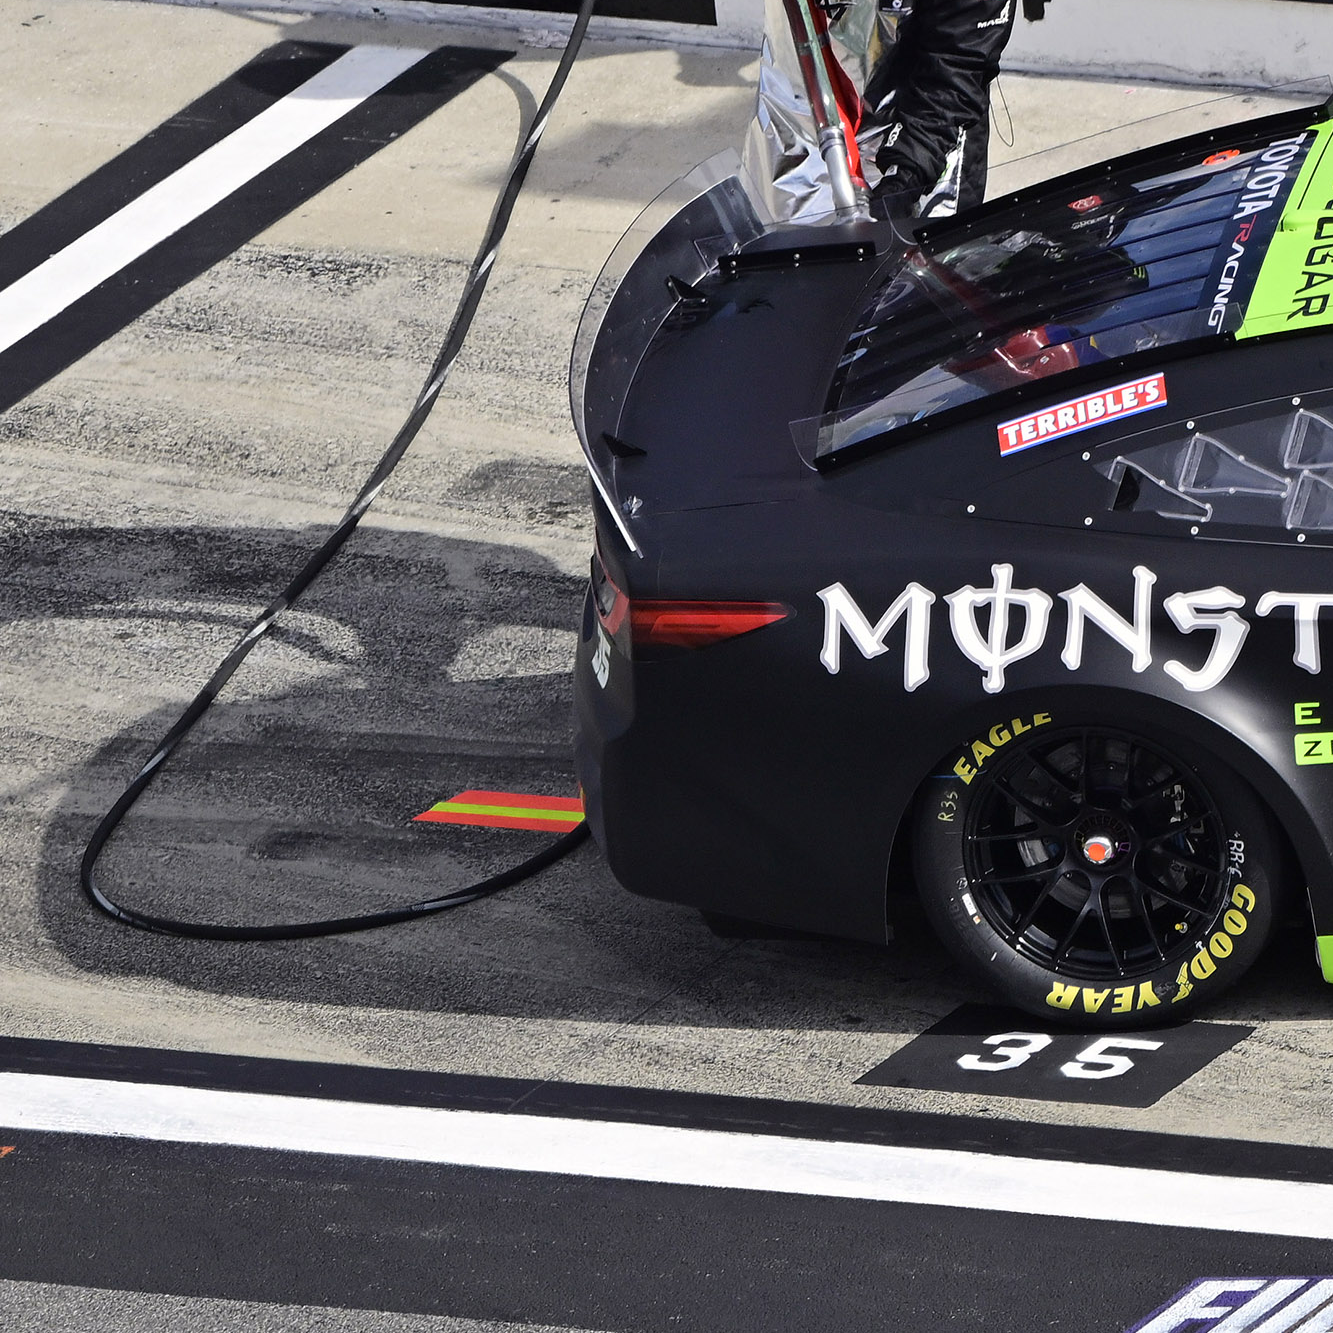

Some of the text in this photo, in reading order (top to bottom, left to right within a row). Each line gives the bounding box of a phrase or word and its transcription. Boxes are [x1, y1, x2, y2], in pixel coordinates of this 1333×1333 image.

[1234, 132, 1309, 222] TOYOTA
[1002, 380, 1160, 447] TERRIBLE'S
[953, 712, 1052, 786] EAGLE
[937, 790, 958, 822] R35
[1045, 883, 1256, 1014] GOODYEAR
[956, 1031, 1164, 1080] 35
